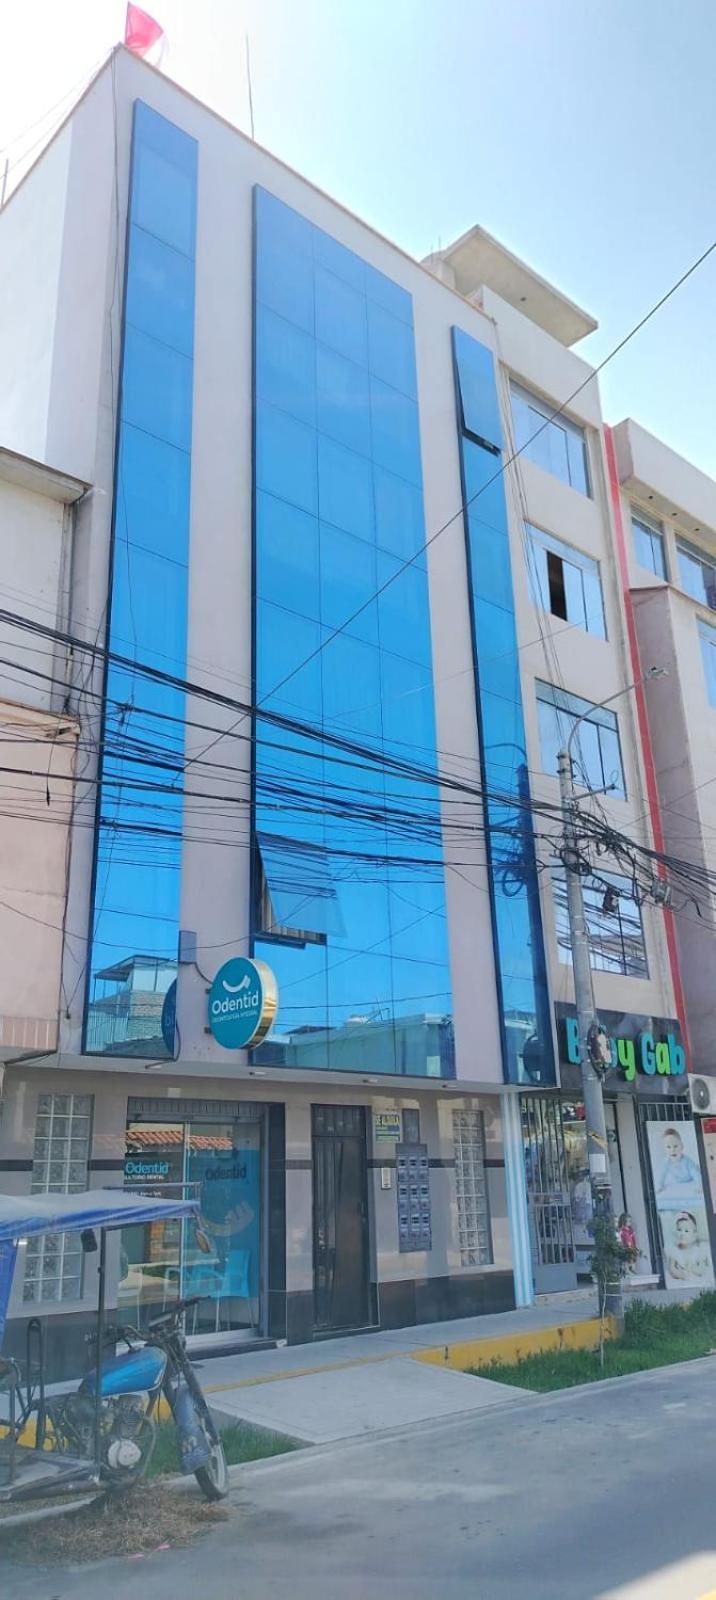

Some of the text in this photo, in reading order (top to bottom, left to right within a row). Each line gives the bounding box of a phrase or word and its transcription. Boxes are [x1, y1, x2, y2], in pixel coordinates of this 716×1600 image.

[211, 991, 259, 1014] Odentid
[641, 1032, 686, 1075] Gab
[125, 1161, 169, 1175] Odentid
[204, 1161, 246, 1180] Odentid
